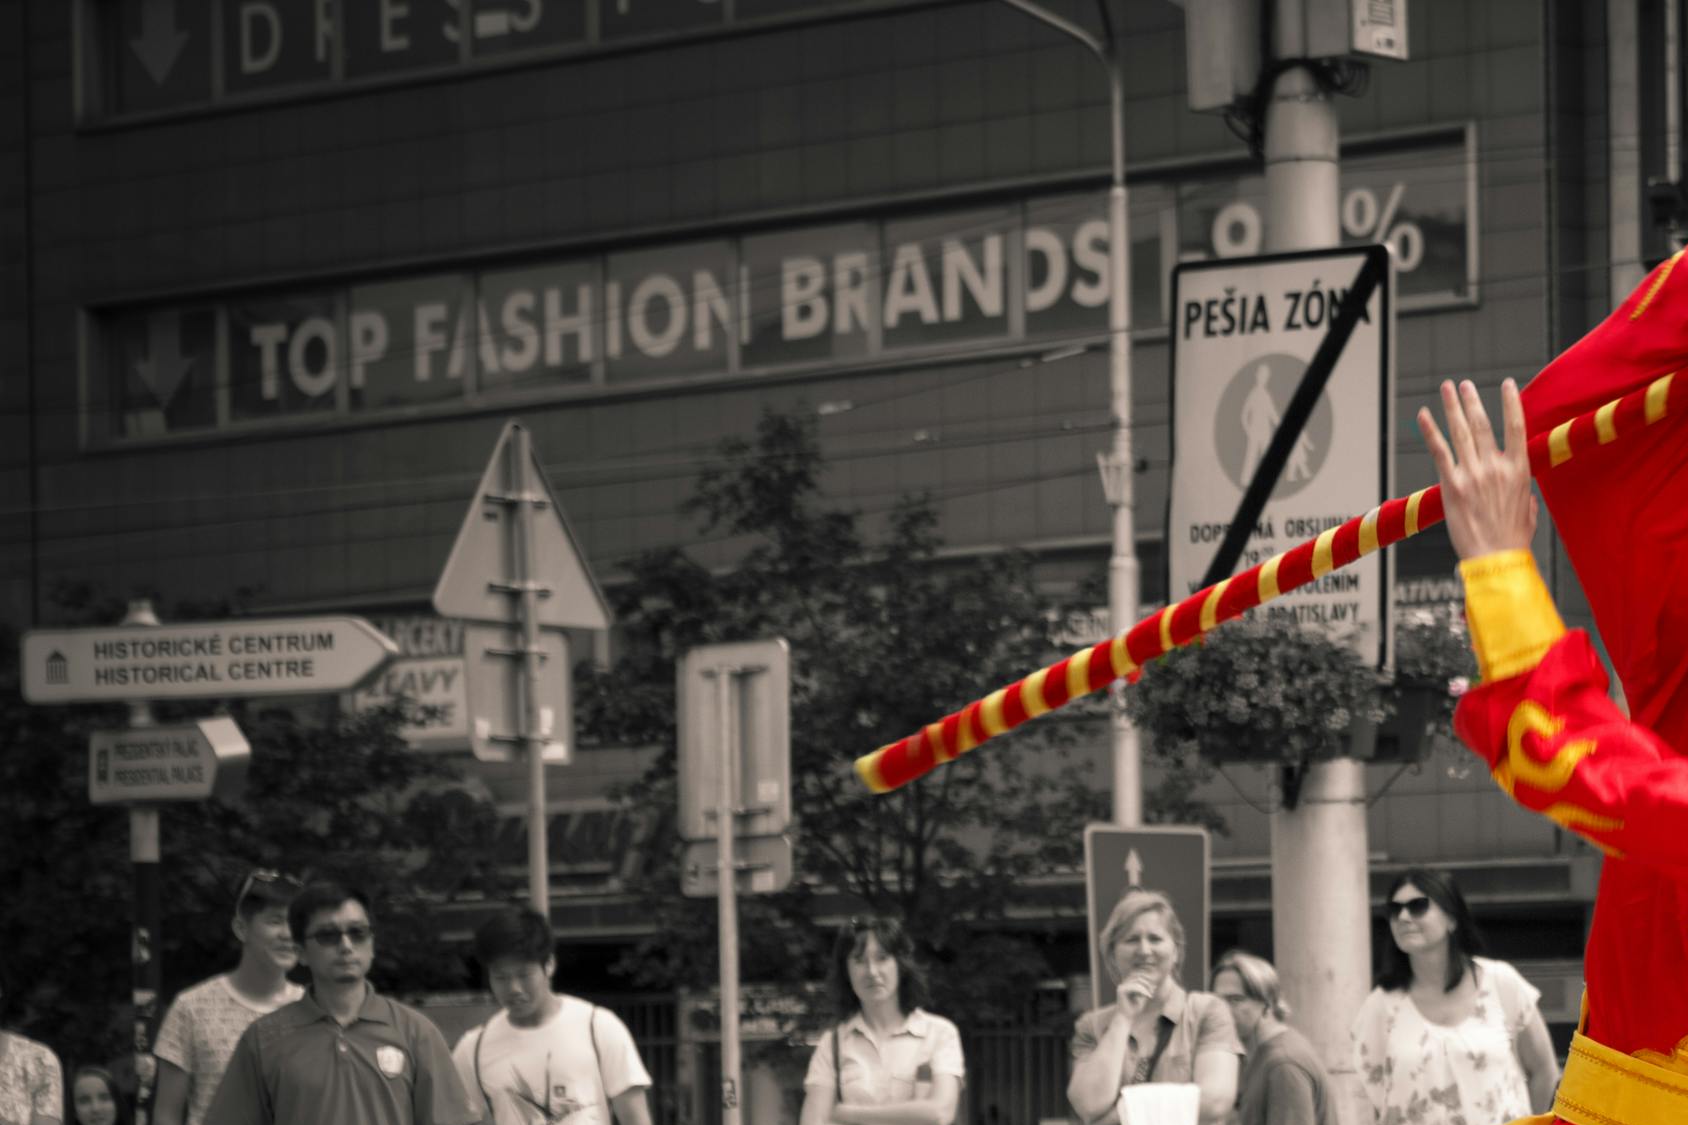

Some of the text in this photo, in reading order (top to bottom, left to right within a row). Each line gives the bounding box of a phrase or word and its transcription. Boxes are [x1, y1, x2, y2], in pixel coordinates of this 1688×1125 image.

[250, 309, 390, 400] TOP
[414, 262, 753, 381] FASHION
[781, 220, 1111, 341] BRANDS
[1184, 278, 1371, 340] PEŠIA ZÓN
[1190, 516, 1353, 543] DOPNÁ OBSLUH
[93, 631, 335, 660] HISTORICKÉ CENTRUM
[94, 659, 315, 686] HISTORICAL CENTRE
